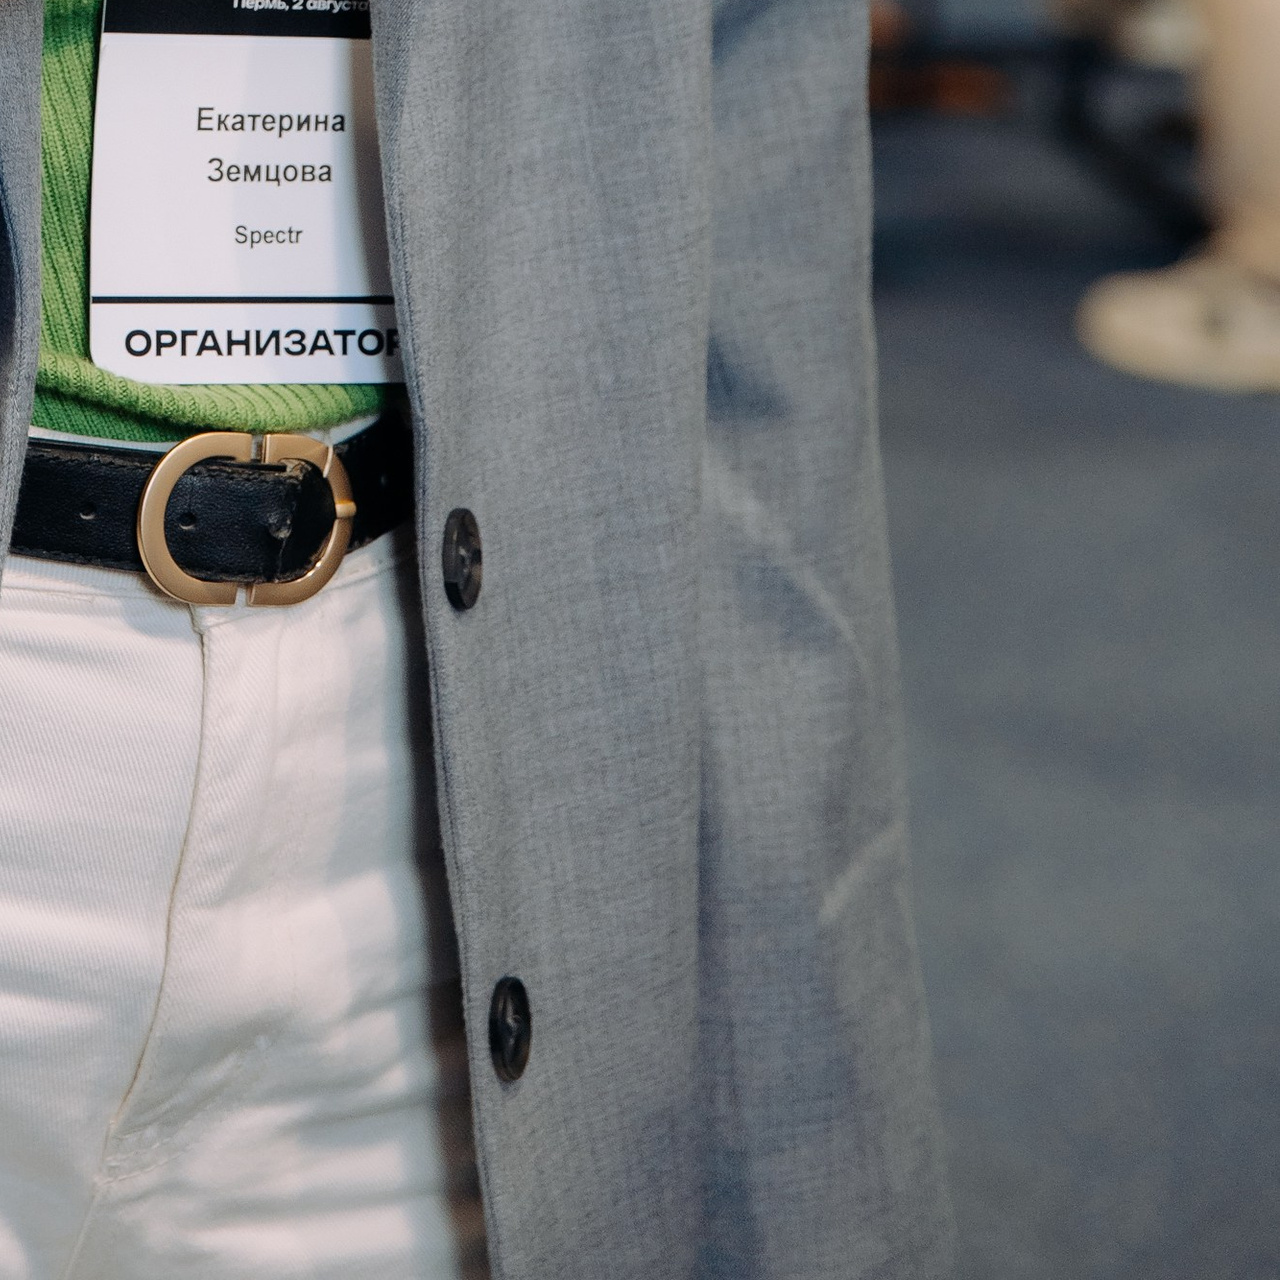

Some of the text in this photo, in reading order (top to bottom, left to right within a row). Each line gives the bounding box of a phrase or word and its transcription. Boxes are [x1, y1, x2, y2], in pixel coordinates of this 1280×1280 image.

[306, 0, 369, 14] августа
[197, 106, 347, 138] Екатерина
[207, 157, 334, 186] Земцова
[234, 225, 304, 249] Spectr
[124, 328, 401, 357] ОРГАНИЗАТОР
